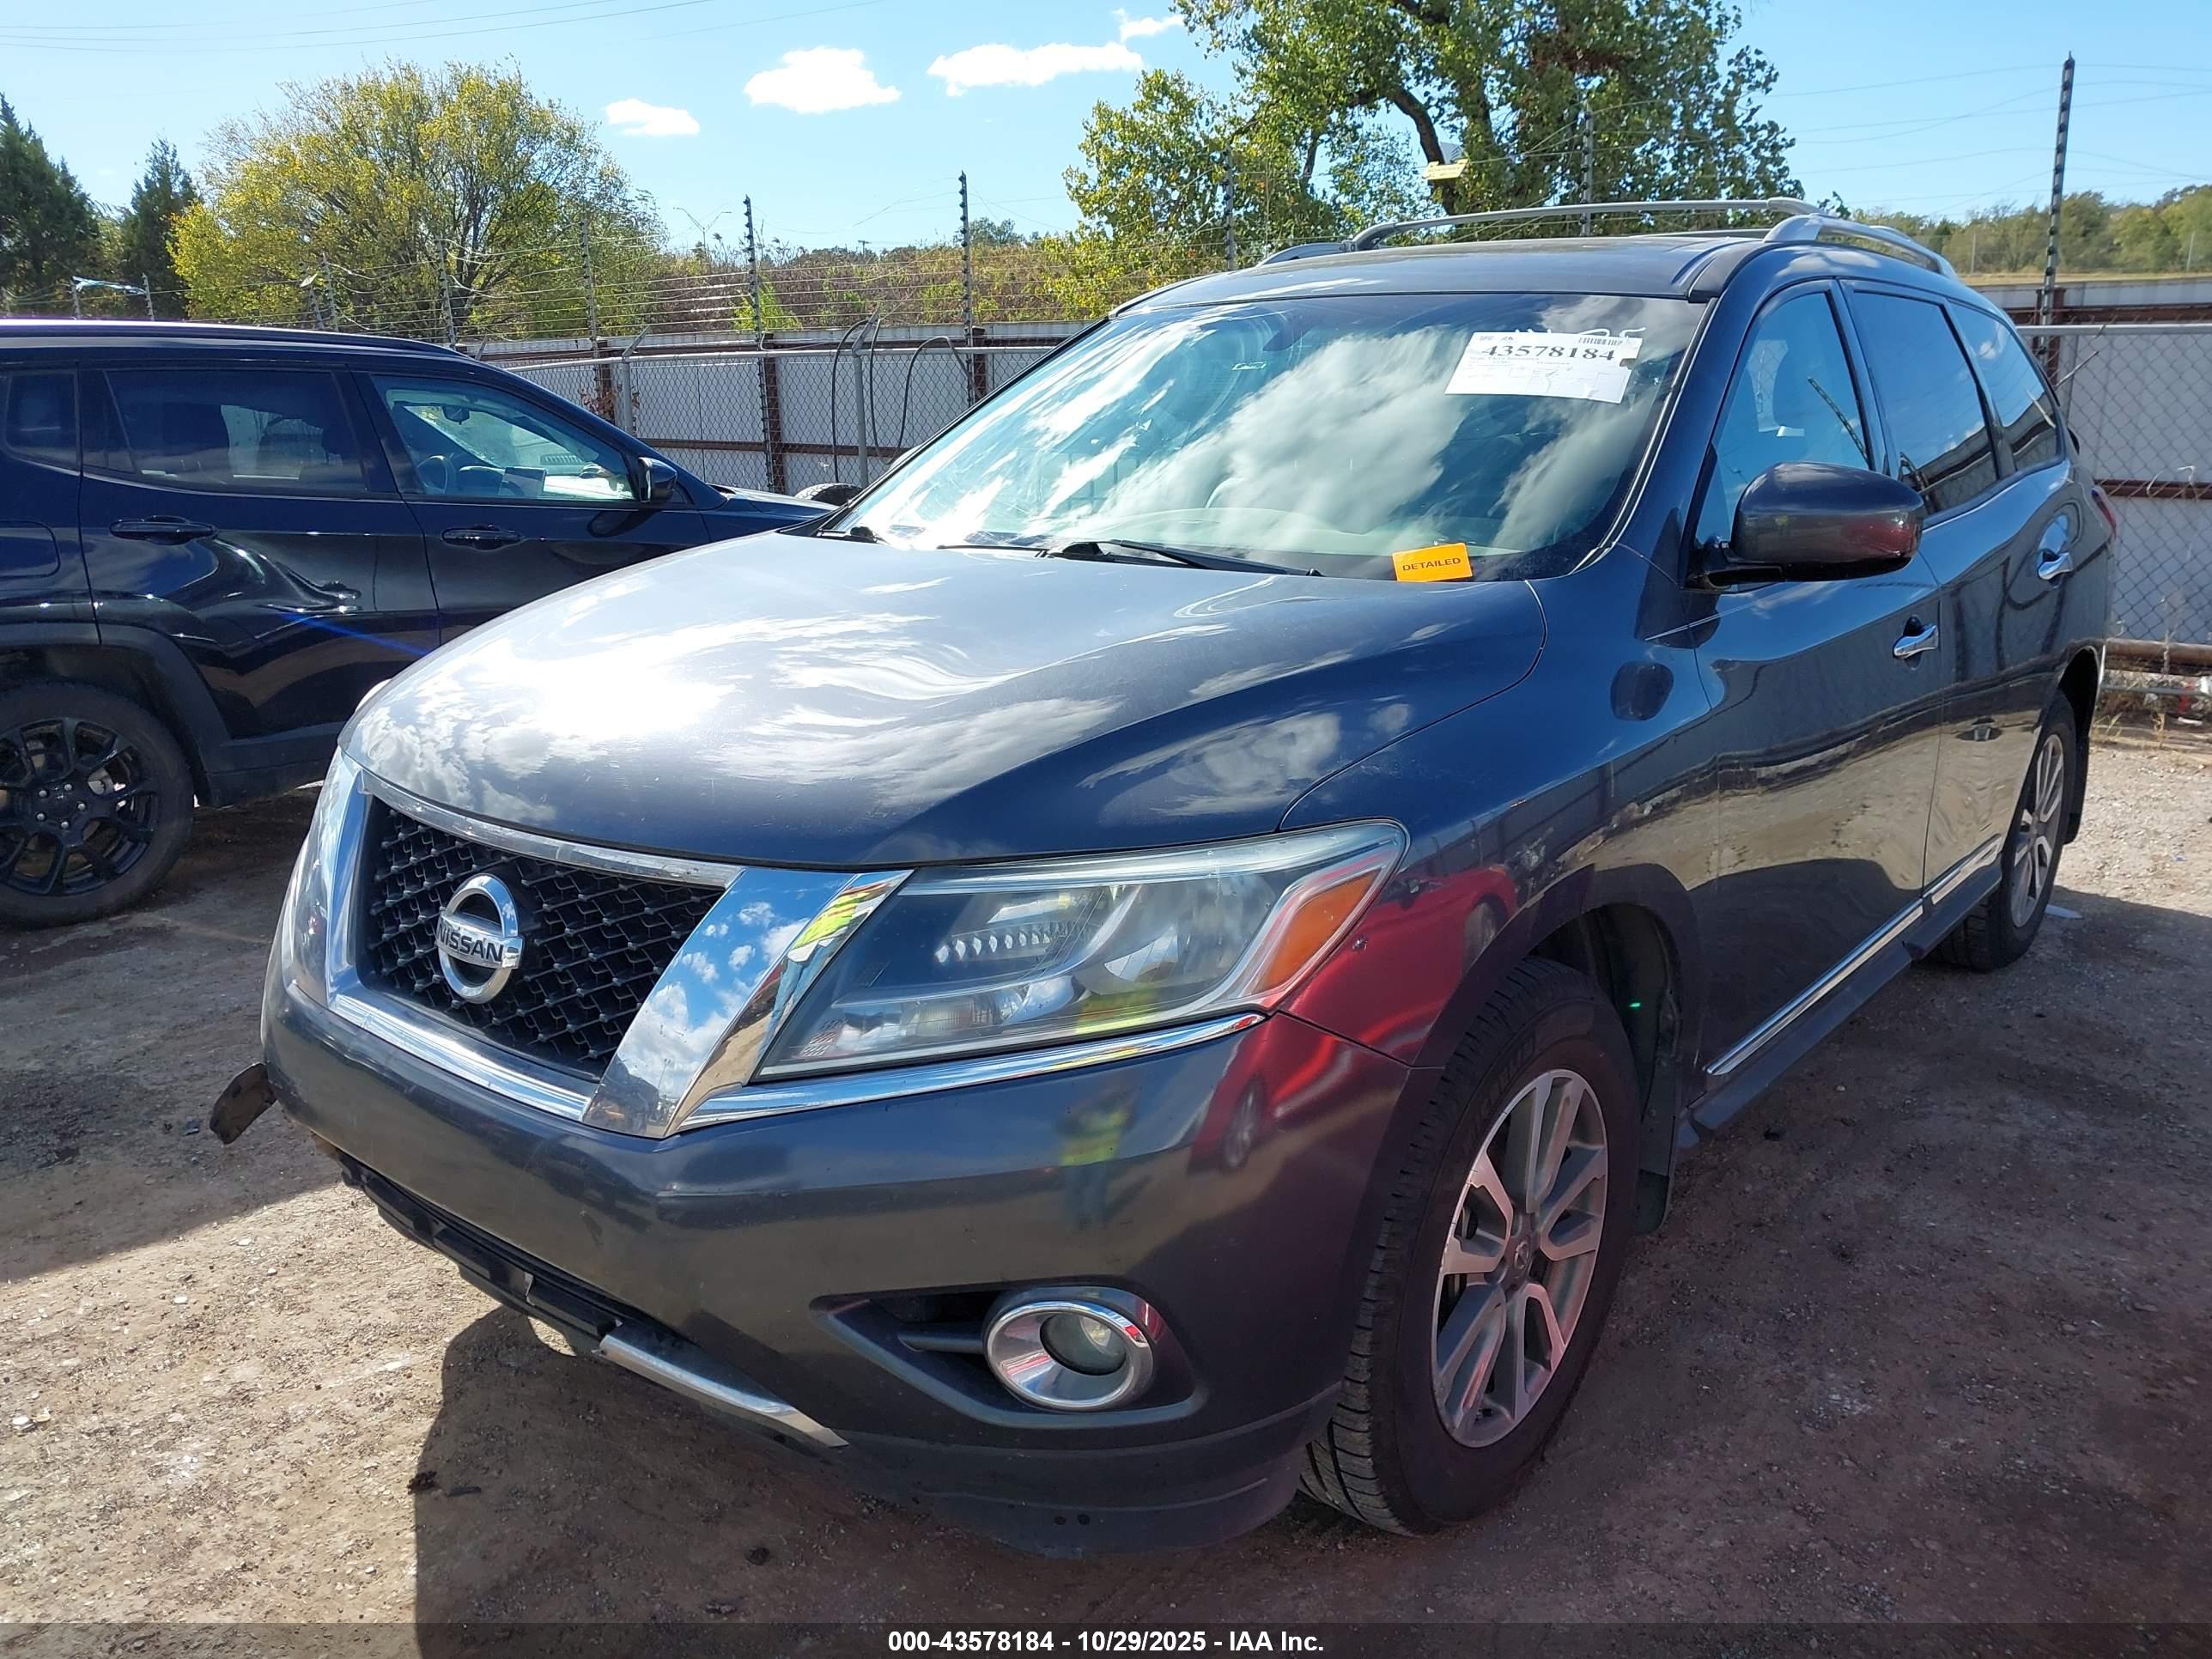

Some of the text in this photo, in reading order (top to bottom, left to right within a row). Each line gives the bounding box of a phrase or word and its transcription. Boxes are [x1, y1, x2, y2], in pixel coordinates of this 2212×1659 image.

[1482, 345, 1614, 361] 43578184
[1402, 557, 1462, 571] DETAILED
[437, 923, 504, 963] NISSAN
